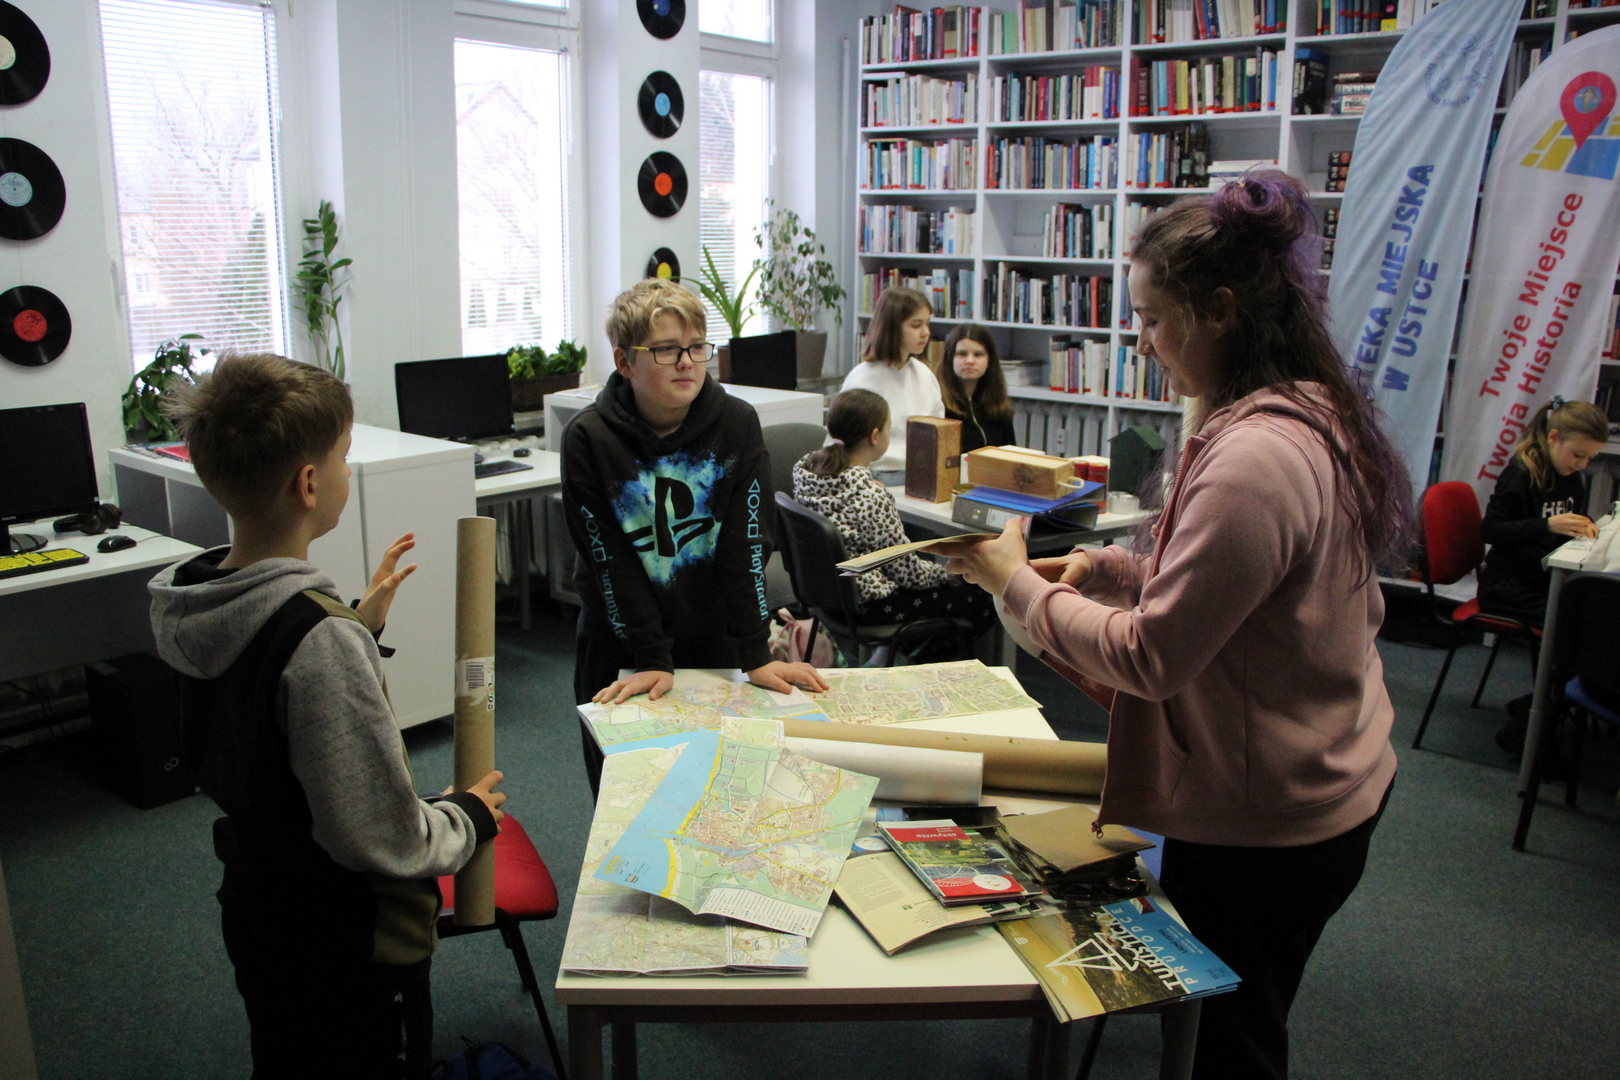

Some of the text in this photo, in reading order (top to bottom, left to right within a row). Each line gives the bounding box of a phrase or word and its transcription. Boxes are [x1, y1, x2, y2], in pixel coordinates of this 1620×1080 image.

[1353, 164, 1435, 380] TEKA MIEJSKA
[1382, 259, 1439, 392] W USTCE
[1479, 192, 1584, 398] Twoje Miejsce
[1477, 281, 1583, 482] Twoja Historia
[750, 544, 769, 621] PlayStation
[602, 855, 621, 874] USTKA
